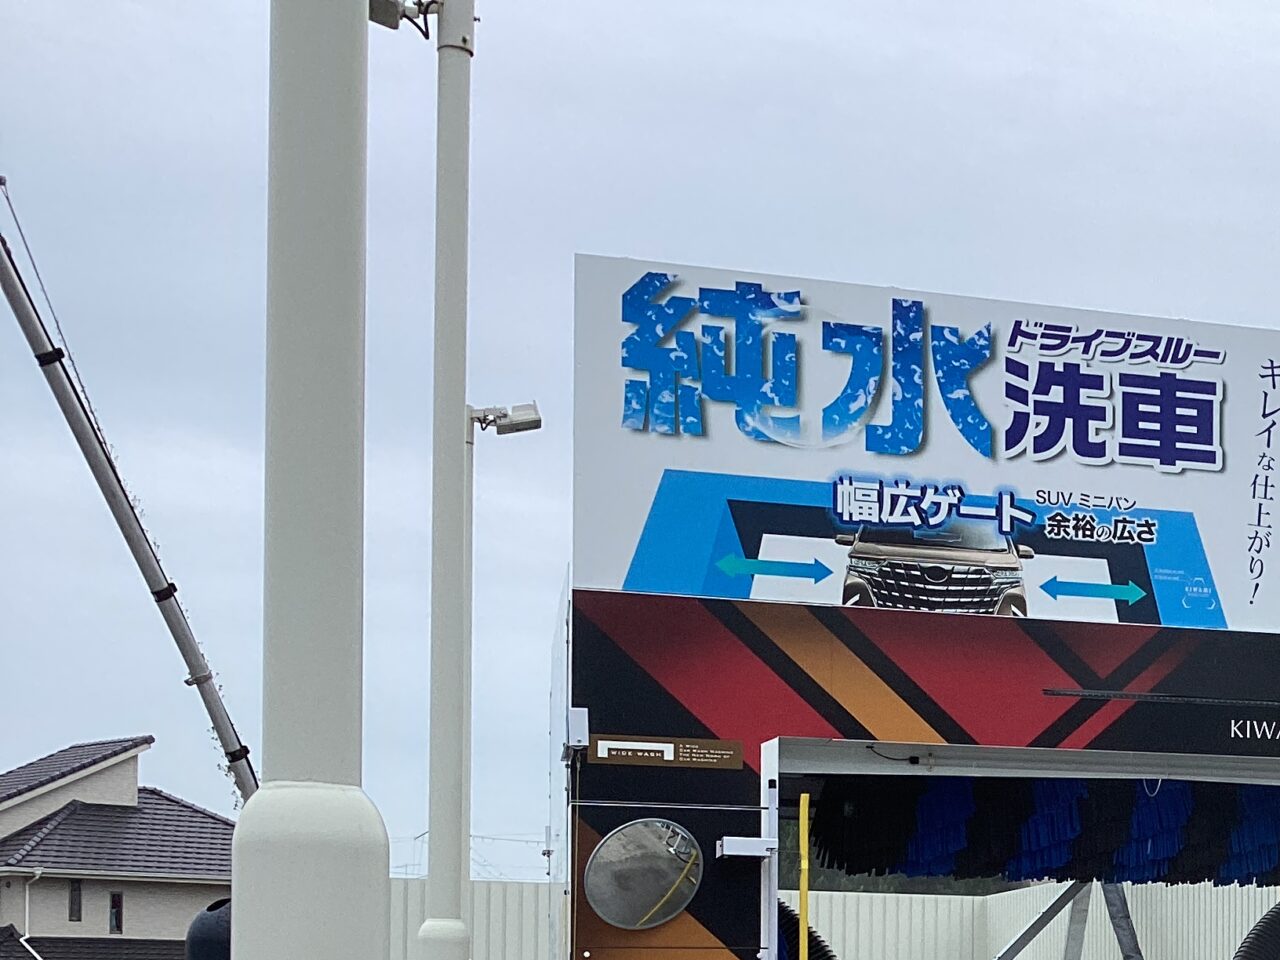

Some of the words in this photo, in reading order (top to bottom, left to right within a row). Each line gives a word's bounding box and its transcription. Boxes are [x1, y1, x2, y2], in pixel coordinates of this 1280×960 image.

[620, 270, 997, 459] 純水
[1007, 320, 1224, 364] ドライブスルー
[1003, 360, 1222, 467] 洗車
[836, 480, 1035, 532] 幅広ゲート
[1036, 489, 1073, 507] SUV
[1078, 492, 1137, 511] ミニバン
[1046, 513, 1157, 544] 余裕の広さ
